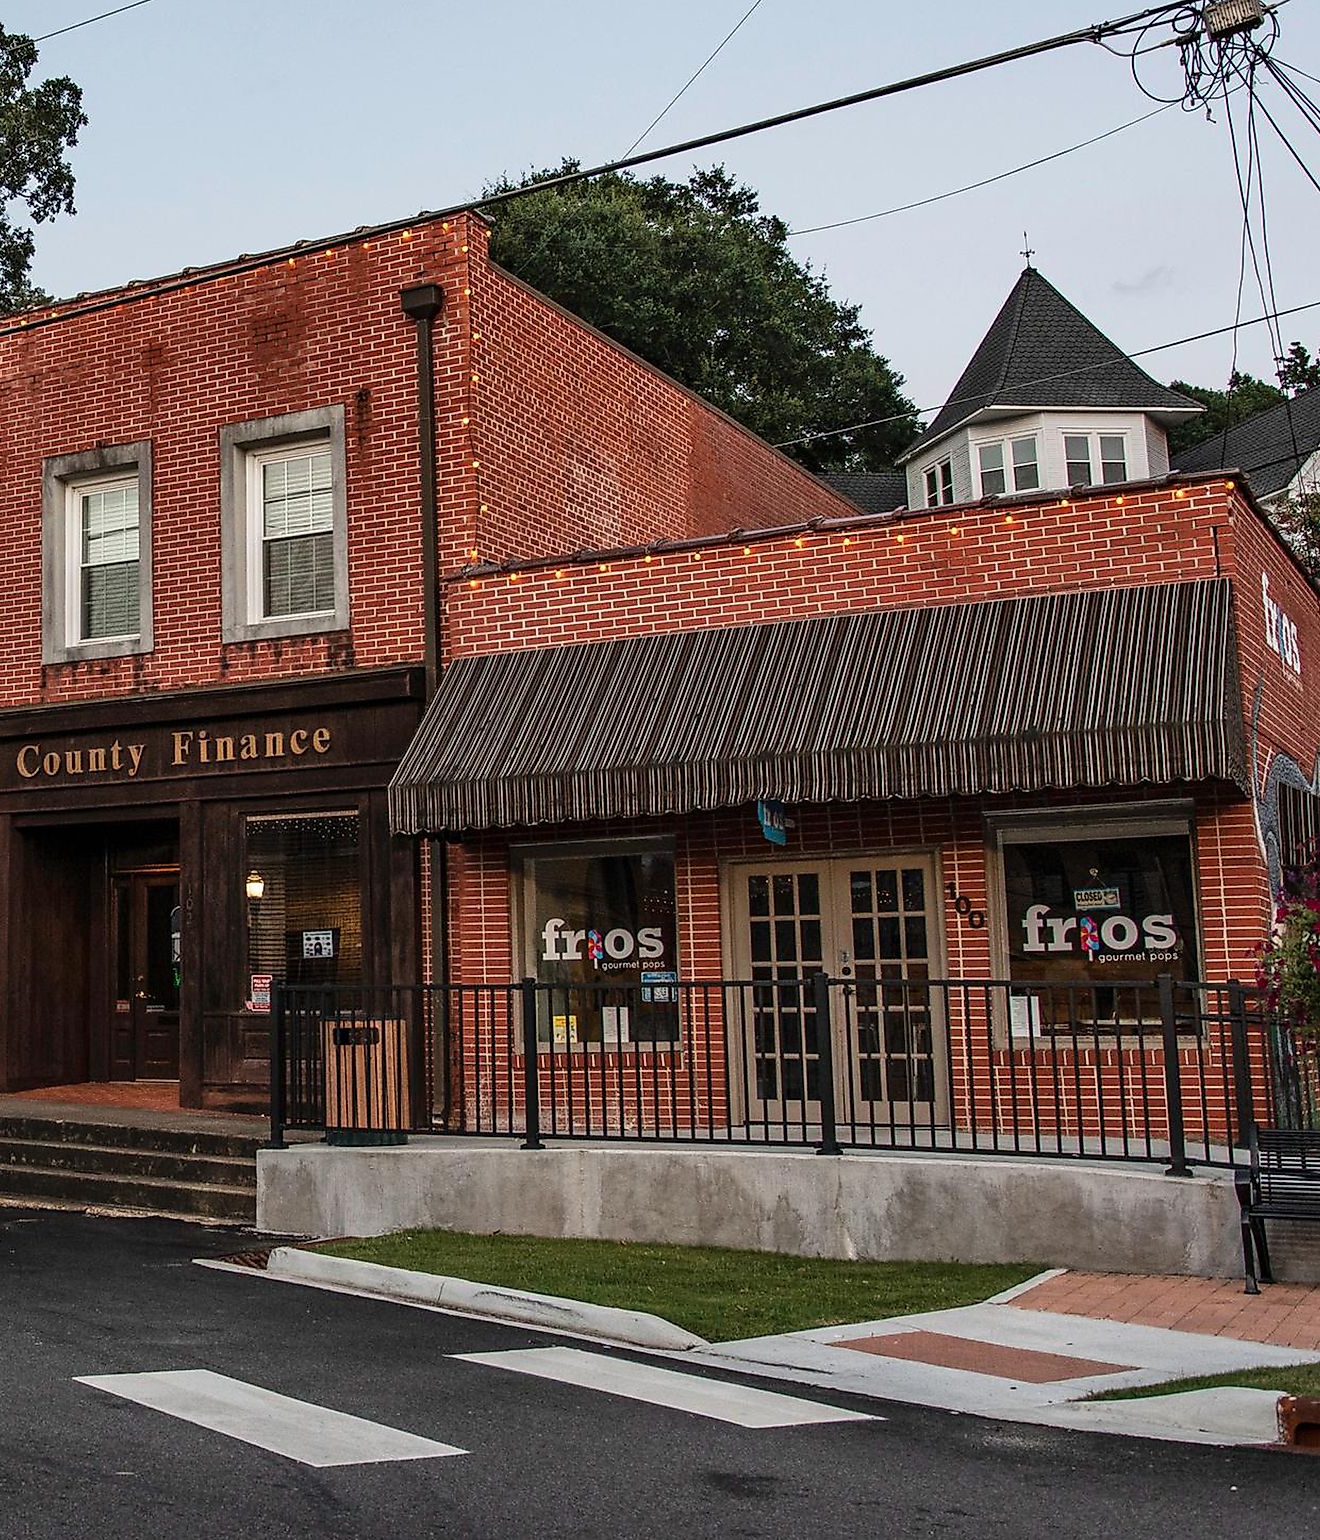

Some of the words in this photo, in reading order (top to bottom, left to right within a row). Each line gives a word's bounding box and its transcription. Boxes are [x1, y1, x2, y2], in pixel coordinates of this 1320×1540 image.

[16, 739, 145, 778] County
[171, 727, 331, 766] Finance
[945, 881, 984, 929] 100
[1076, 891, 1103, 902] CLOSED
[541, 917, 665, 968] frios
[1021, 903, 1177, 962] frios
[601, 960, 640, 972] gourmet
[642, 960, 666, 970] pops
[1098, 952, 1146, 964] gourmet
[1149, 951, 1179, 963] pops
